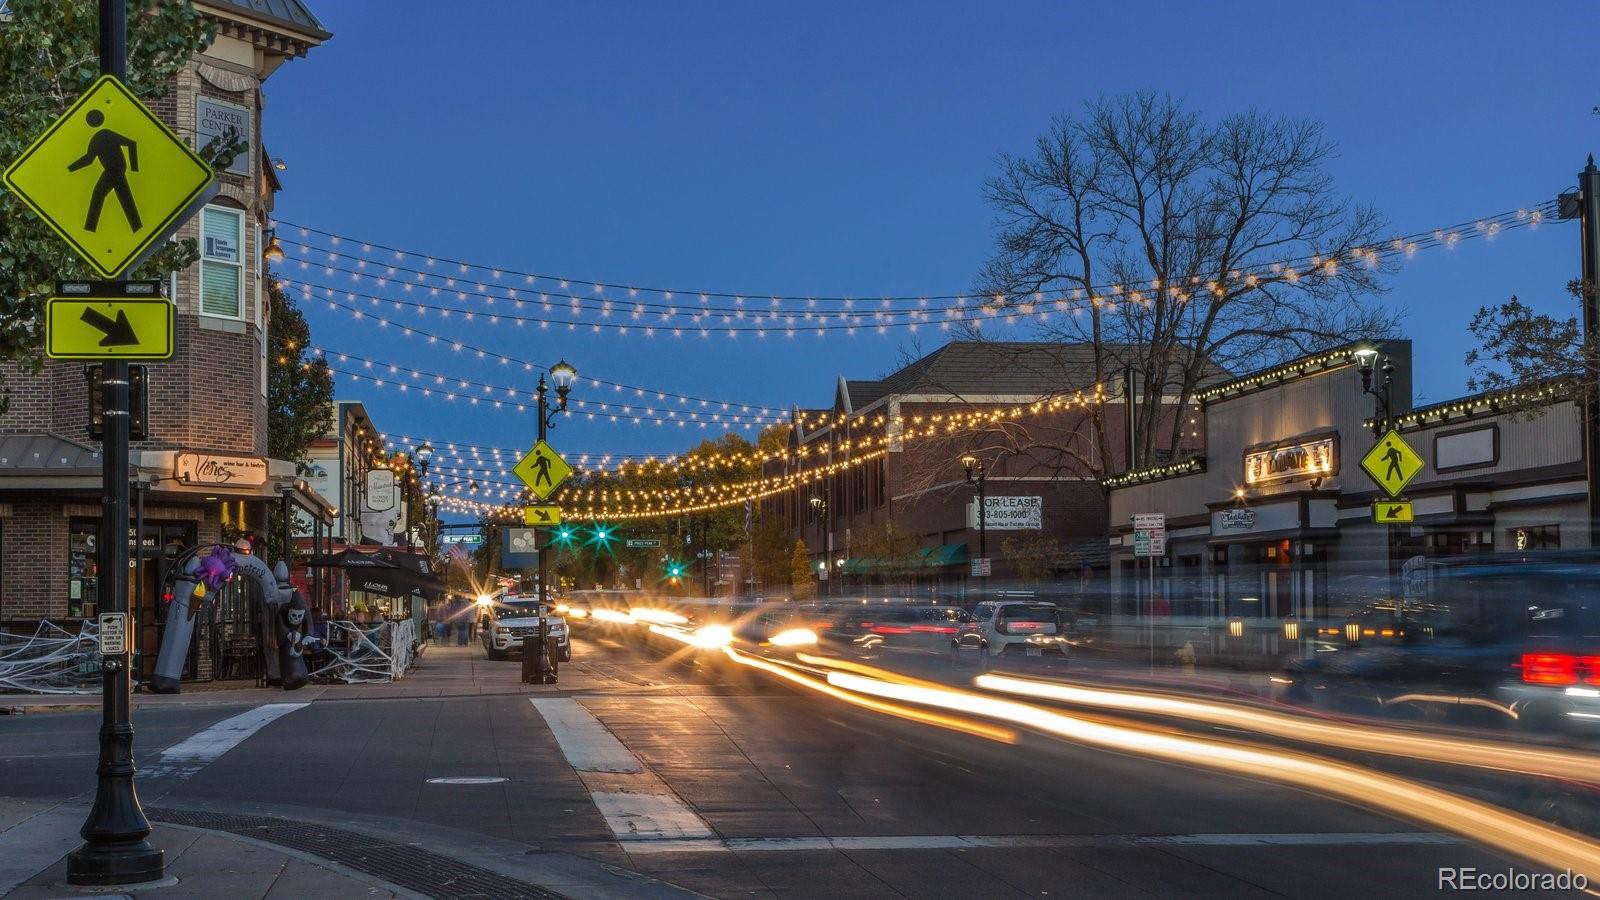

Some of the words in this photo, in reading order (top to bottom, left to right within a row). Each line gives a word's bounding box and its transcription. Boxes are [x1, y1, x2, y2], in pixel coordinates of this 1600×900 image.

[205, 107, 242, 125] PARKER
[201, 118, 246, 137] CENTL
[1004, 498, 1038, 507] LEASE
[976, 510, 1027, 519] 33-805-1000
